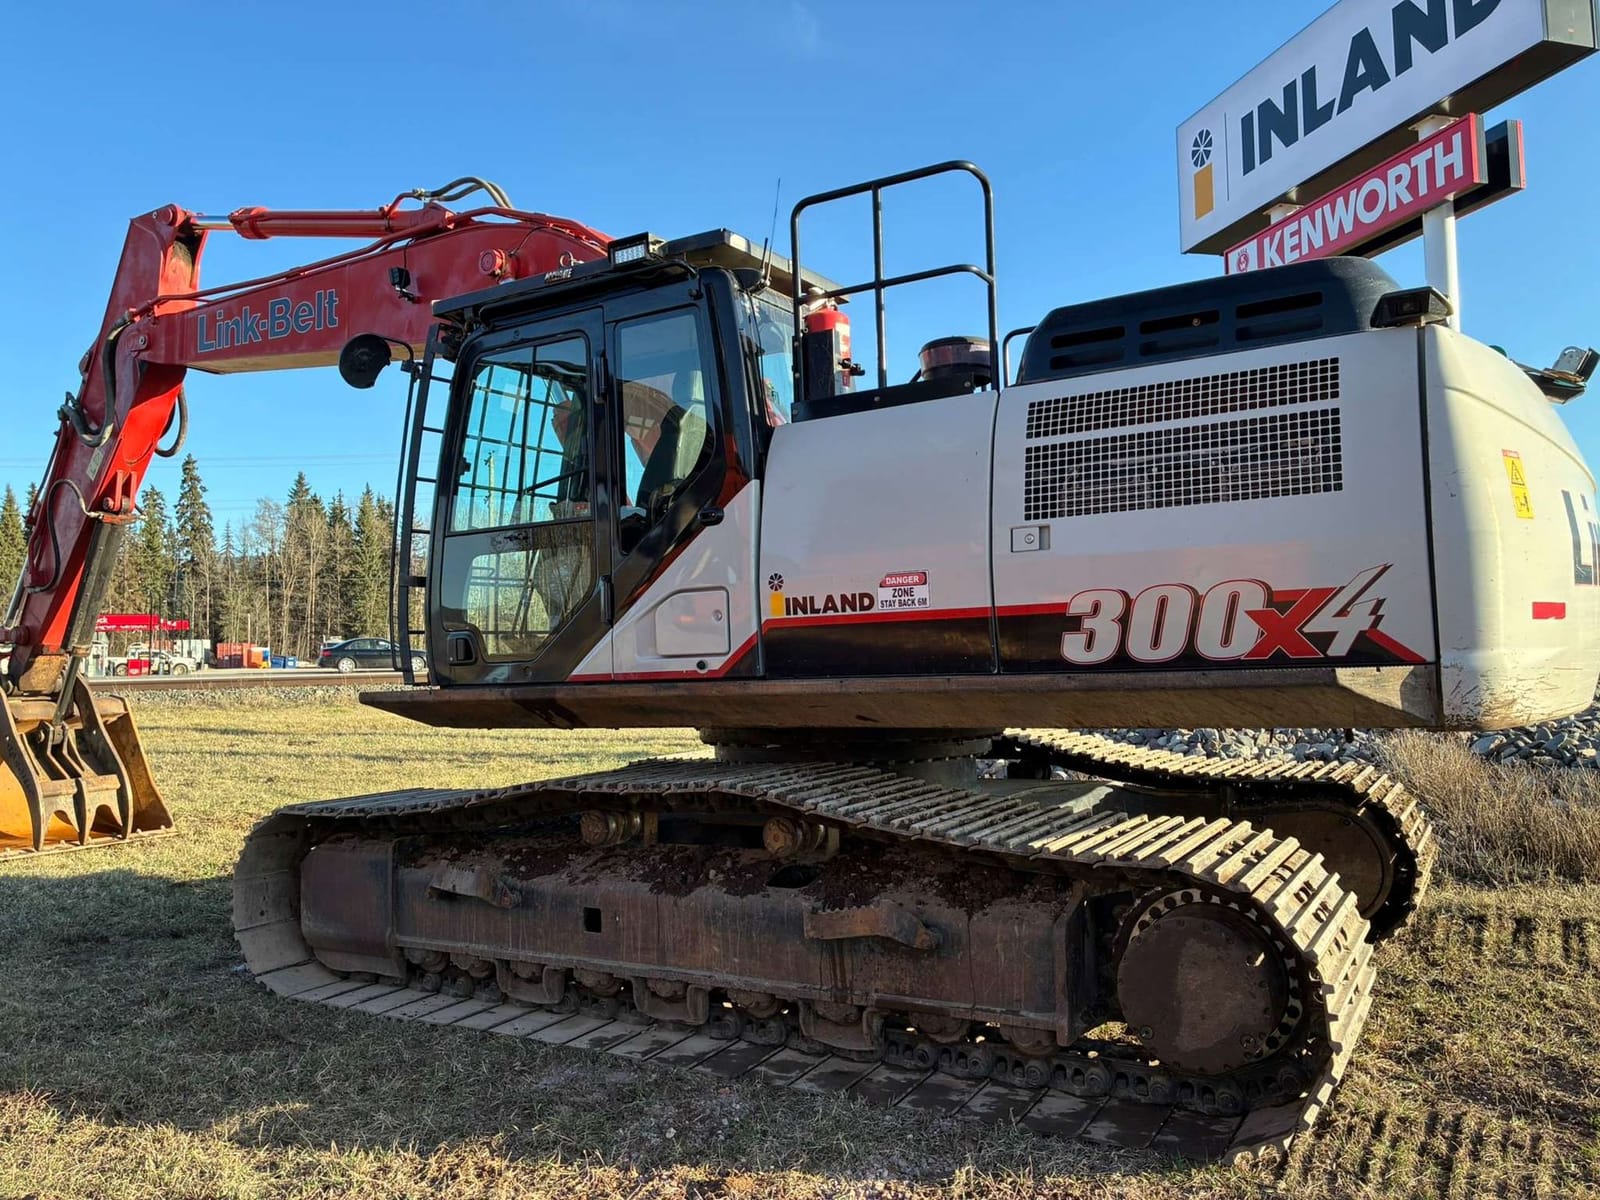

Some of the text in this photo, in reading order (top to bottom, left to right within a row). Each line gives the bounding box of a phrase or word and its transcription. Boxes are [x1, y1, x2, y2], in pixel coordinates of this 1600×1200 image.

[1263, 132, 1464, 269] KENWORTH
[197, 289, 339, 353] Link-Belt
[885, 575, 920, 585] DANGER
[892, 587, 915, 598] ZONE
[785, 592, 875, 616] INLAND
[880, 599, 897, 608] STAY
[897, 598, 916, 607] BACK
